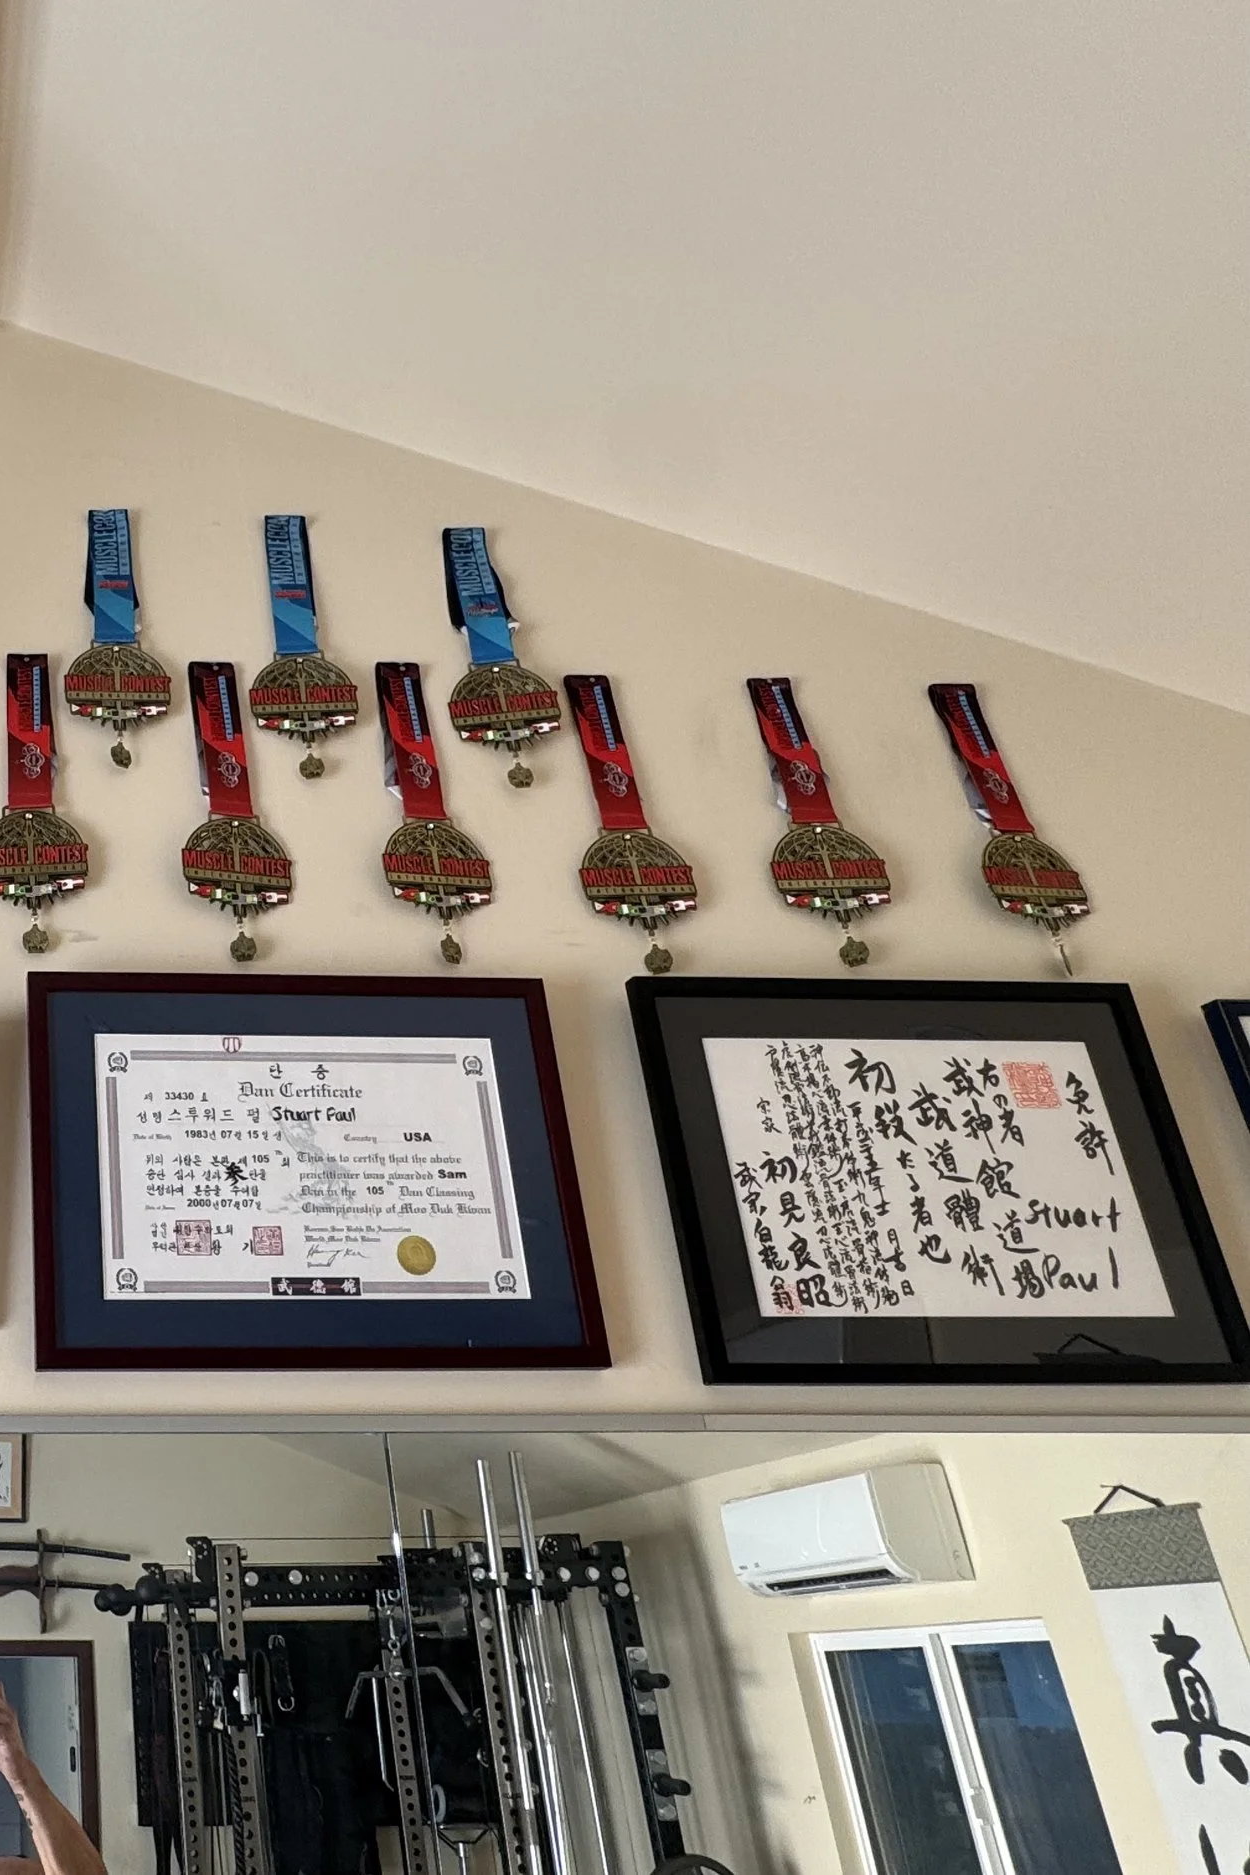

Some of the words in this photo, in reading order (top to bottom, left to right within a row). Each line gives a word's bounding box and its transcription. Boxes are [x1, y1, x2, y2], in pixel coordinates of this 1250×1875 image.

[250, 688, 301, 705] MUSCLE
[306, 685, 358, 703] CONTEST
[449, 697, 501, 719] MUSCLE
[505, 691, 558, 714] CONTEST
[34, 844, 87, 865] CONTEST
[182, 849, 234, 871] MUSCLE
[240, 855, 291, 878] CONTEST
[384, 854, 434, 875] MUSCLE
[440, 858, 490, 879] CONTEST
[581, 868, 635, 887] MUSCLE
[640, 866, 693, 885] CONTEST
[773, 861, 828, 880] MUSCLE
[831, 859, 887, 879] CONTEST
[164, 1091, 195, 1101] 33430
[237, 1081, 273, 1102] Dan
[279, 1082, 363, 1099] Certificate
[271, 1105, 322, 1122] Stuart
[403, 1132, 433, 1143] USA
[252, 1154, 270, 1164] 105
[297, 1151, 324, 1164] This
[437, 1169, 468, 1180] Sam
[366, 1186, 385, 1196] 105
[301, 1201, 383, 1217] Championship
[1024, 1194, 1122, 1234] Stuart
[1041, 1244, 1120, 1292] Paul
